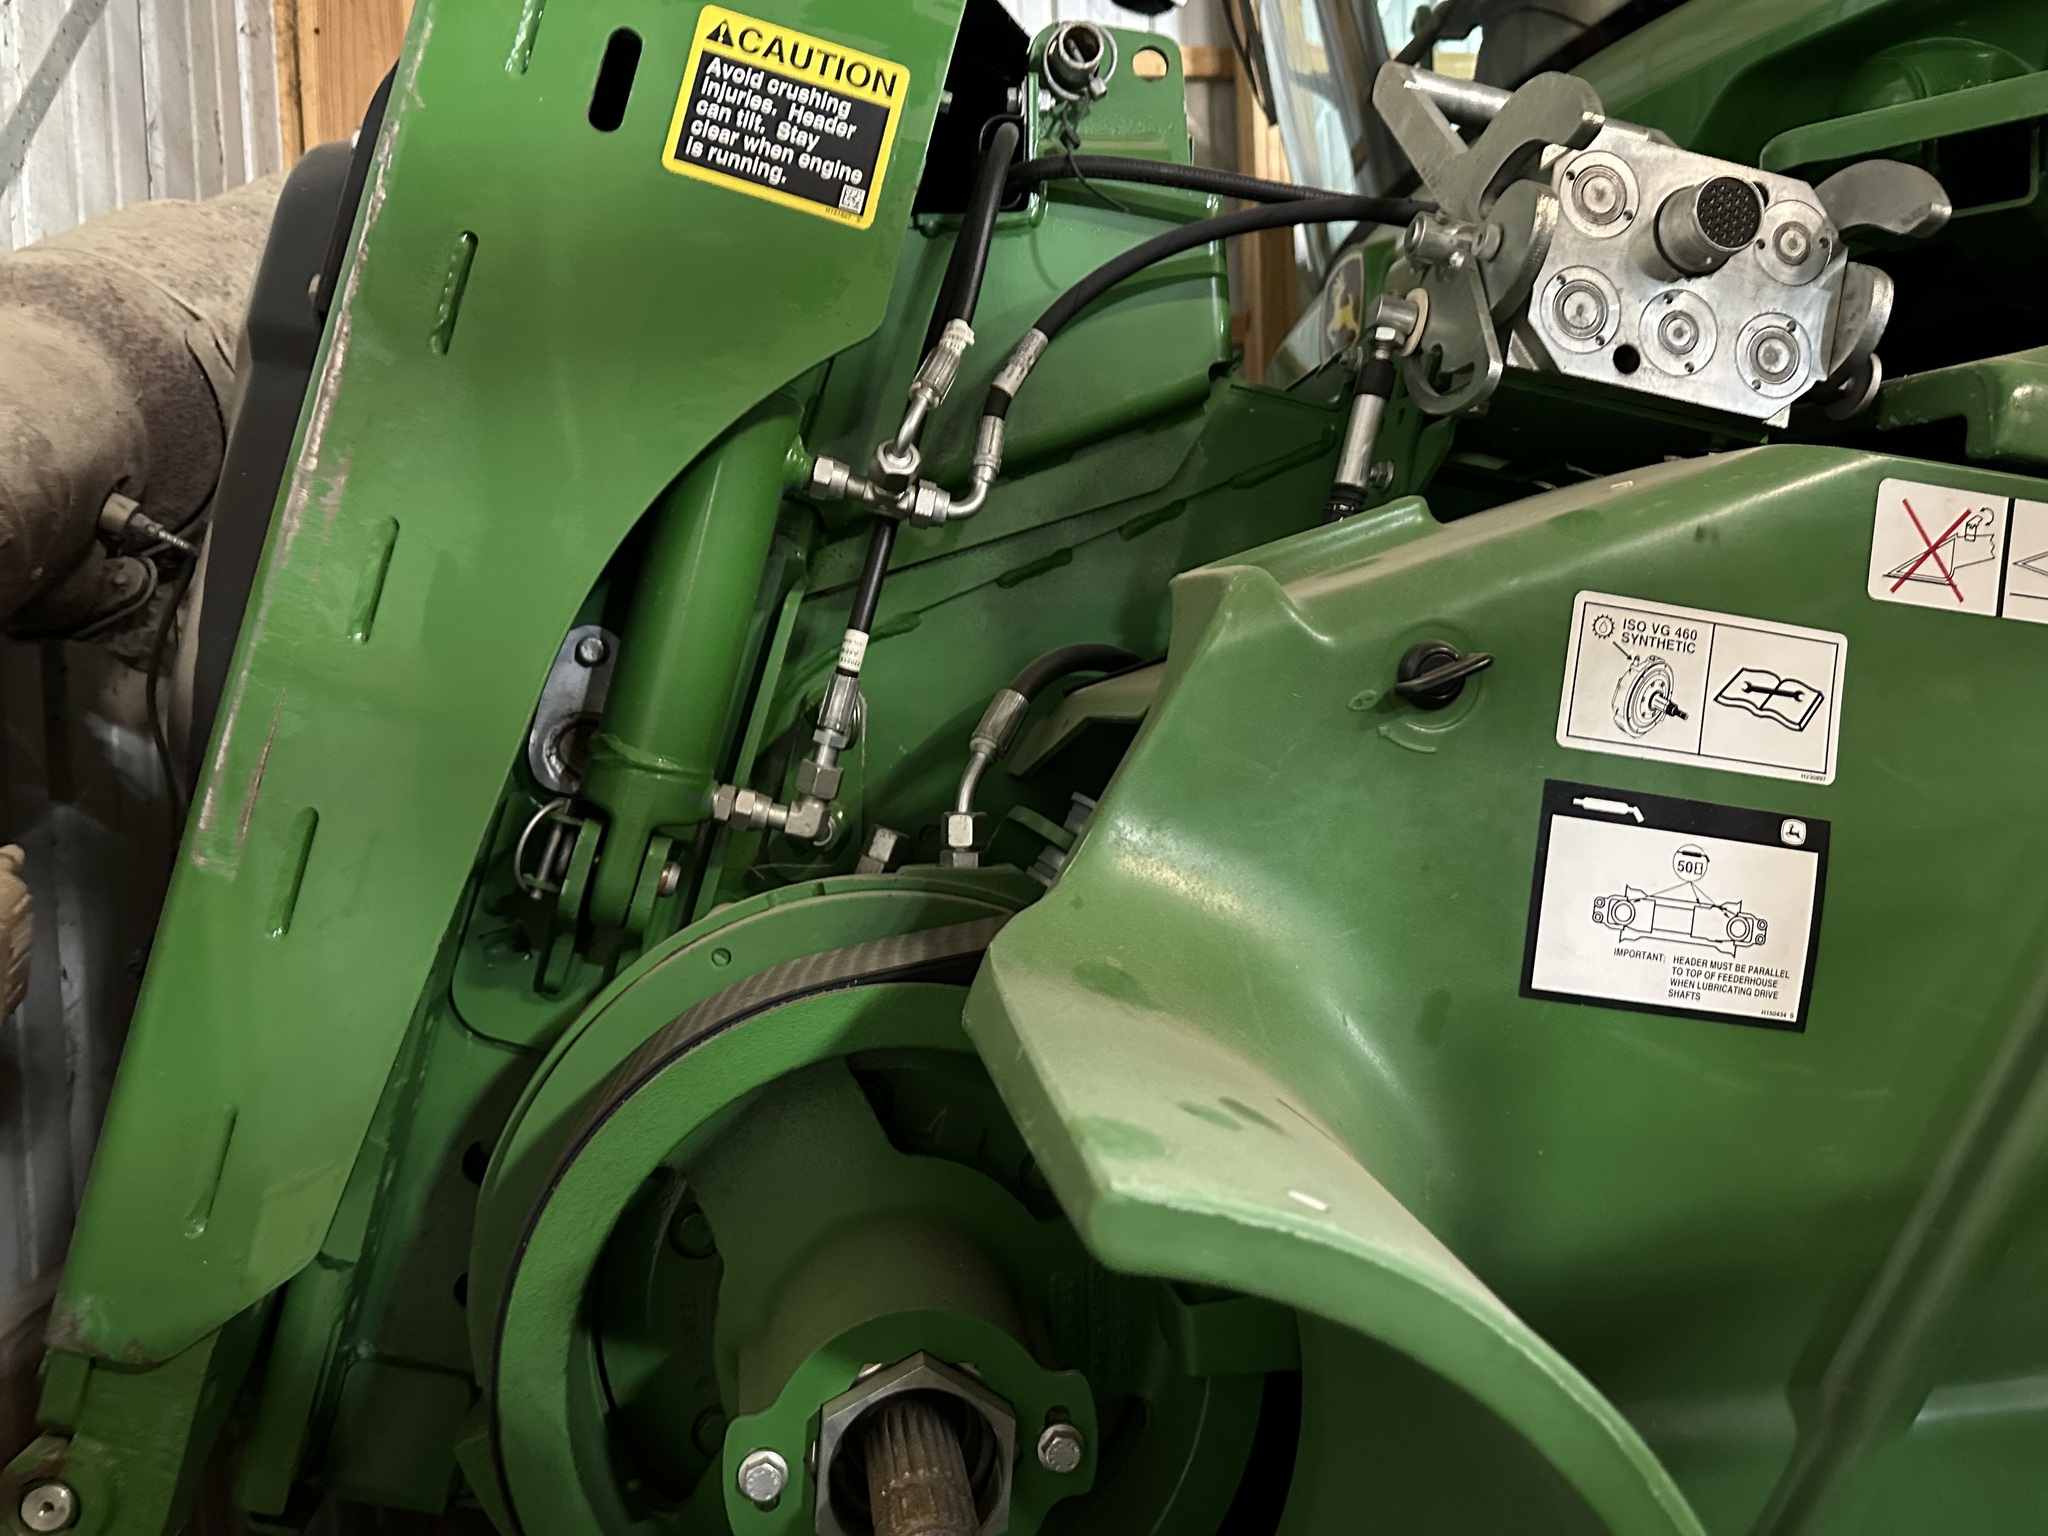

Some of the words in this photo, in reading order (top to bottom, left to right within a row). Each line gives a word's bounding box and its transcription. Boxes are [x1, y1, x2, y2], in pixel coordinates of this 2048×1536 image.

[738, 27, 897, 97] CAUTION
[705, 56, 764, 89] Avoid
[767, 75, 852, 119] crushing
[701, 76, 777, 117] injuries.
[788, 102, 857, 140] Header
[696, 99, 731, 124] can
[736, 107, 766, 134] tilt.
[776, 121, 820, 152] Stay
[685, 136, 703, 158] is
[708, 147, 787, 185] running.
[691, 119, 739, 146] clear
[743, 135, 795, 164] when
[798, 151, 863, 184] engine
[1621, 631, 1696, 654] SYNTHETIC
[1623, 617, 1647, 633] ISO
[1652, 622, 1670, 636] VG
[1675, 627, 1698, 641] 460
[1677, 860, 1693, 873] 50
[1614, 947, 1666, 964] IMPORTANT:
[1673, 955, 1708, 968] HEADER
[1709, 961, 1733, 971] MUST
[1734, 963, 1746, 973] BE
[1748, 965, 1790, 979] PARALLEL
[1672, 966, 1683, 976] TO
[1686, 968, 1702, 978] TOP
[1704, 970, 1716, 980] OF
[1717, 972, 1778, 988] FEEDERHOUSE
[1668, 988, 1701, 1001] SHAFTS
[1670, 977, 1695, 989] WHEN
[1697, 979, 1752, 997] LUBRICATING
[1754, 988, 1779, 1000] DRIVE
